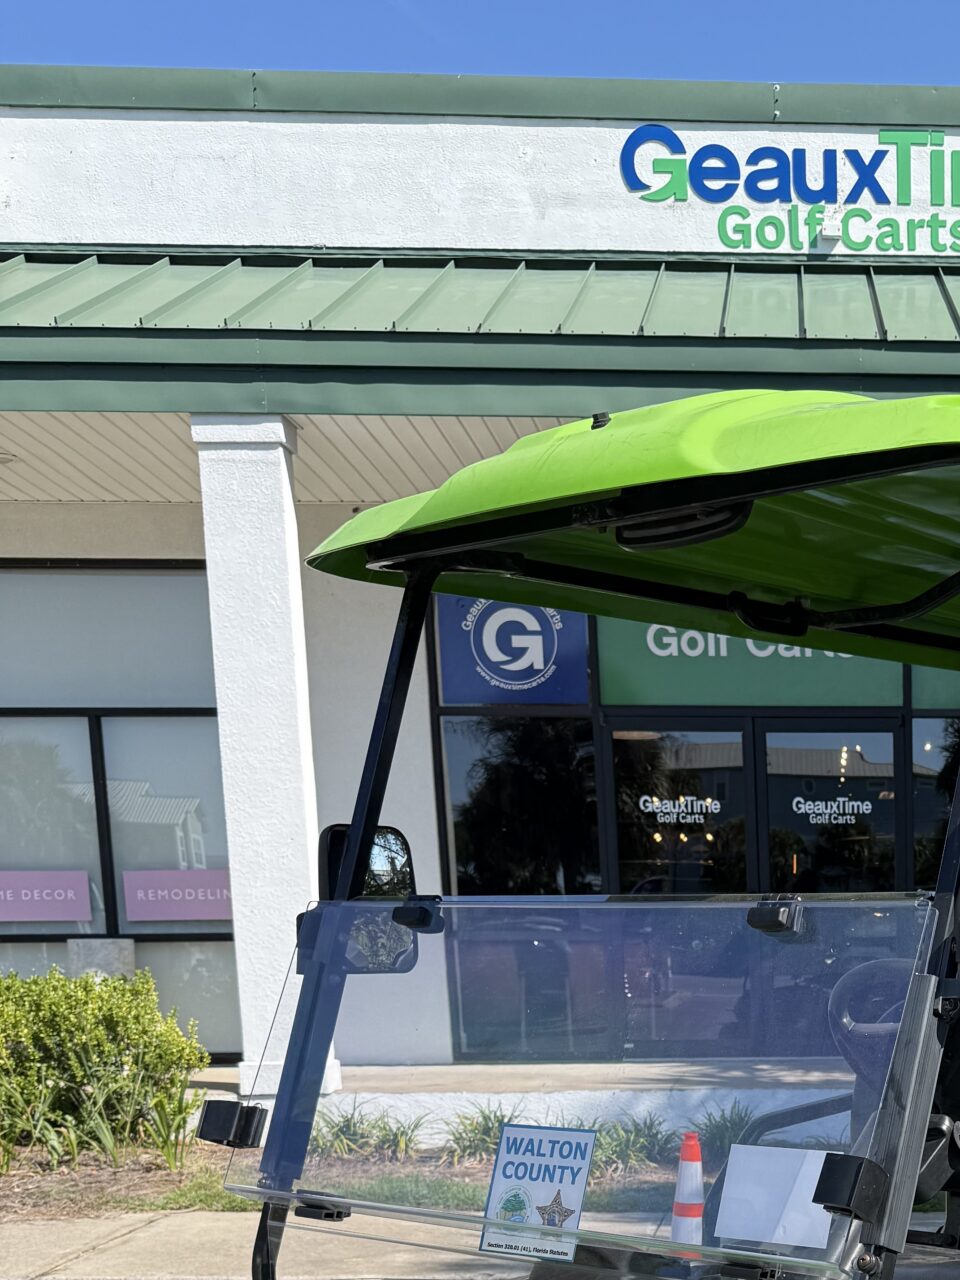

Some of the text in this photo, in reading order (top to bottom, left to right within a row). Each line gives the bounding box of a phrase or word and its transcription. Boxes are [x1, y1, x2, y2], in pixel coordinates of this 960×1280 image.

[717, 204, 825, 250] Golf
[639, 795, 721, 813] GeauxTime
[792, 797, 872, 814] GeauxTime
[656, 813, 704, 824] Golf Carts
[809, 813, 856, 824] Golf Carts
[21, 889, 77, 901] DECOR
[137, 888, 231, 901] REMODELIN
[505, 1136, 588, 1161] WALTON
[501, 1161, 583, 1185] COUNTY
